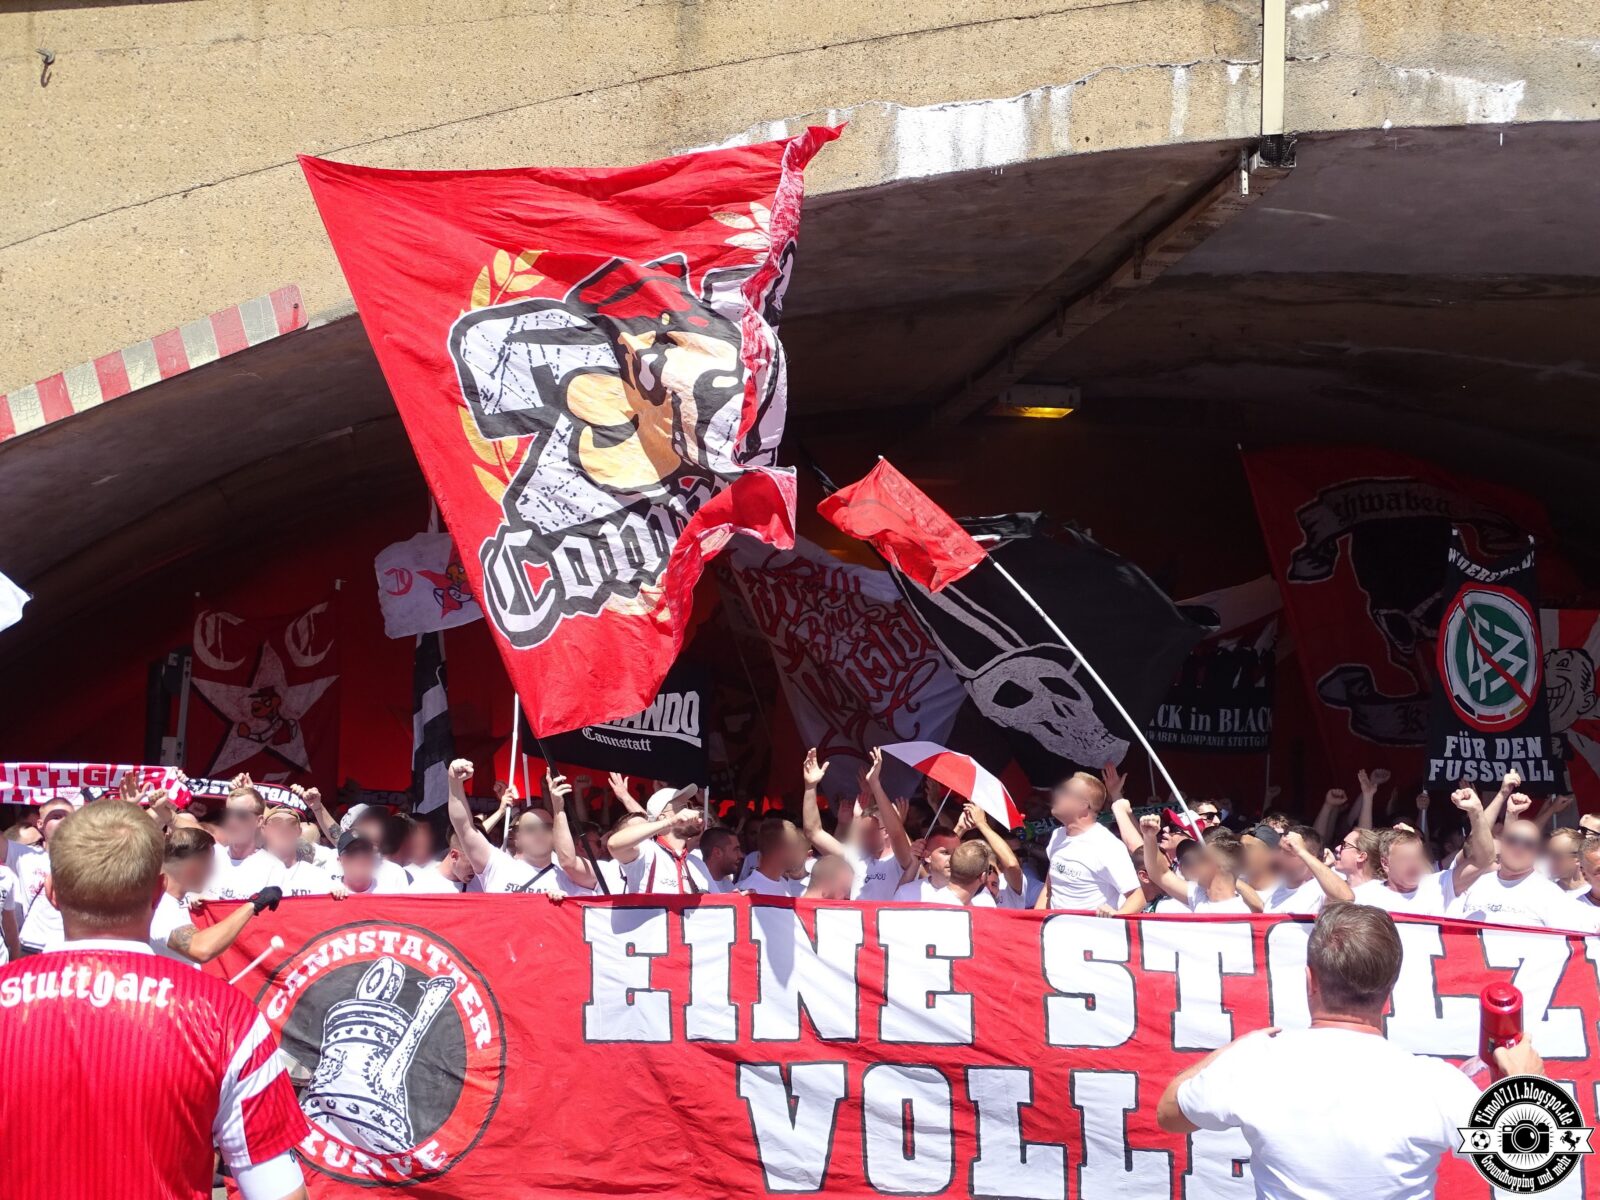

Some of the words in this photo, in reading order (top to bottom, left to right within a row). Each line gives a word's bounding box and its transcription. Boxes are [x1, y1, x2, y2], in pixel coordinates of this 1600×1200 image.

[1190, 706, 1212, 732] in
[581, 726, 652, 751] Cannstatt
[1444, 731, 1487, 760] FÜR
[1495, 736, 1543, 760] DEN
[1428, 758, 1555, 782] FUSSBALL
[266, 929, 493, 1049] CANNSTATTER
[582, 904, 975, 1046] EINE
[299, 1128, 449, 1179] KURVE
